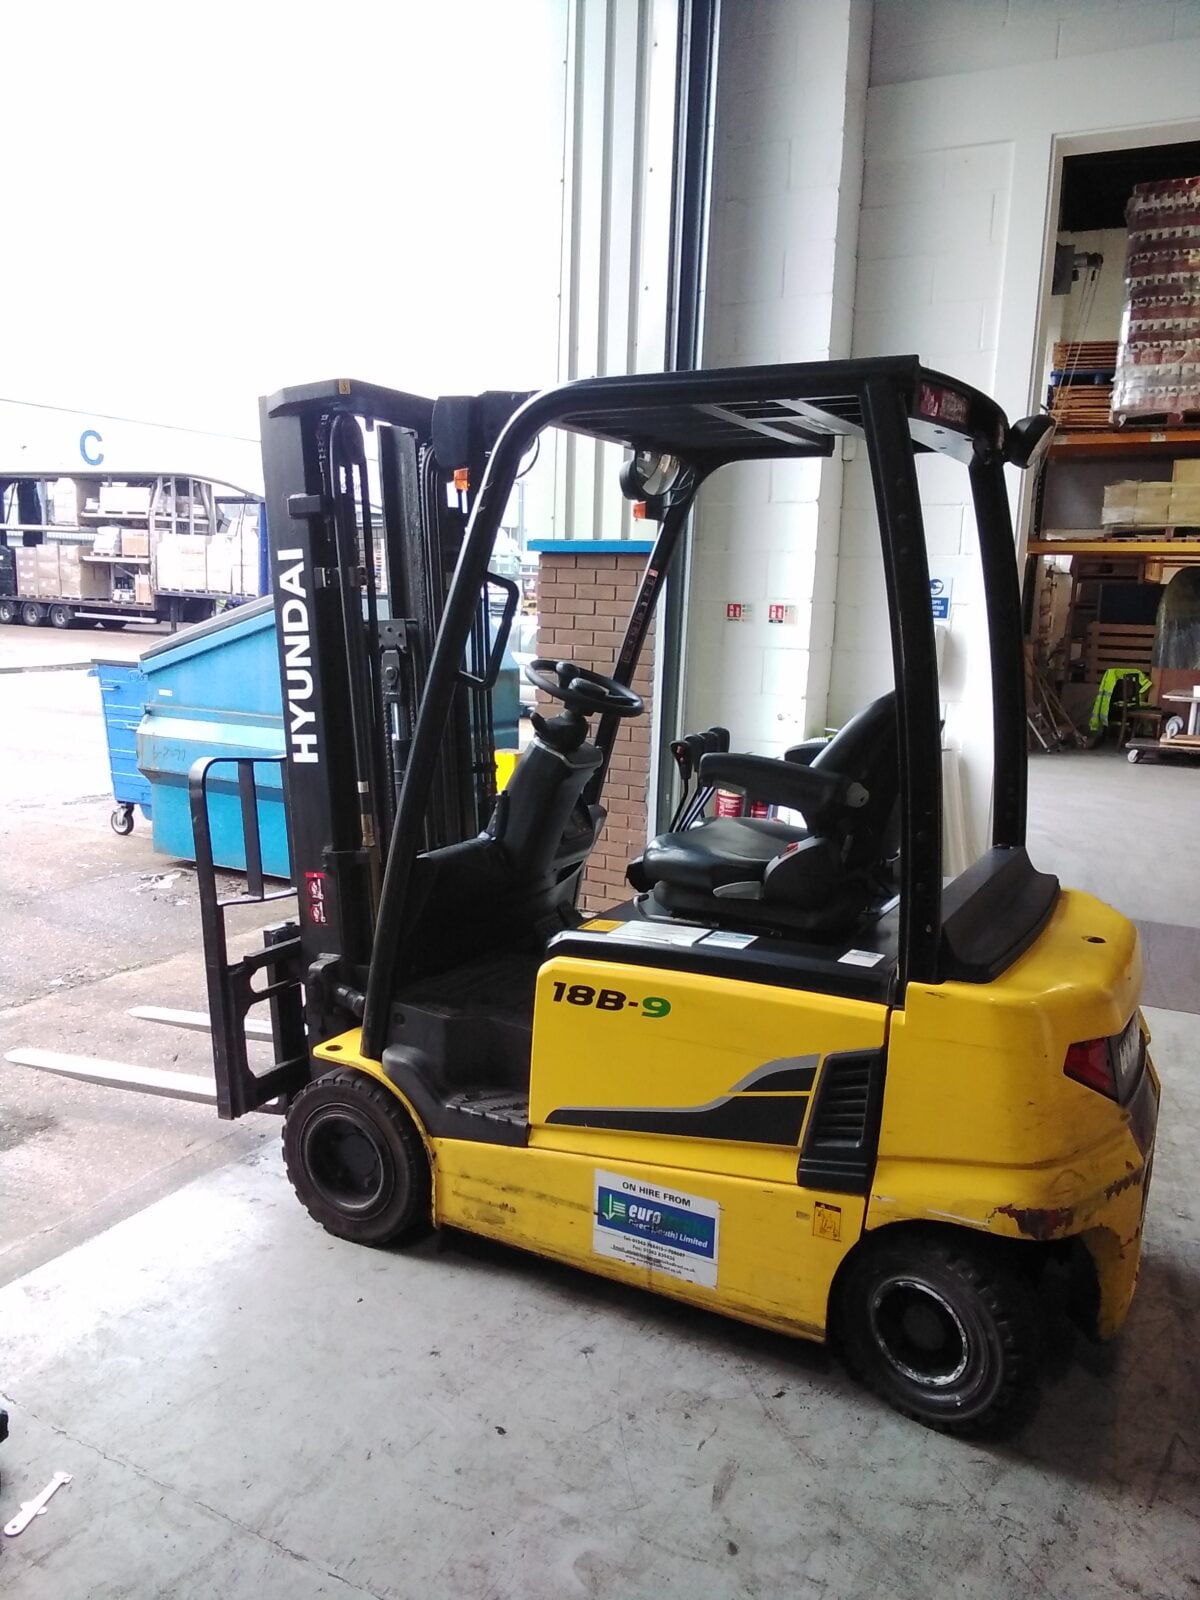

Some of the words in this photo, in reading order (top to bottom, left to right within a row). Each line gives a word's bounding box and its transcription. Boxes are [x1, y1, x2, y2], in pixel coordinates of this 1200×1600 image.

[80, 430, 104, 466] C
[277, 548, 319, 763] HYUNDAI
[553, 981, 671, 1018] 18B-9
[622, 1181, 636, 1192] ON
[639, 1186, 660, 1199] HIRE
[663, 1193, 691, 1207] FROM
[679, 1233, 708, 1248] Limited
